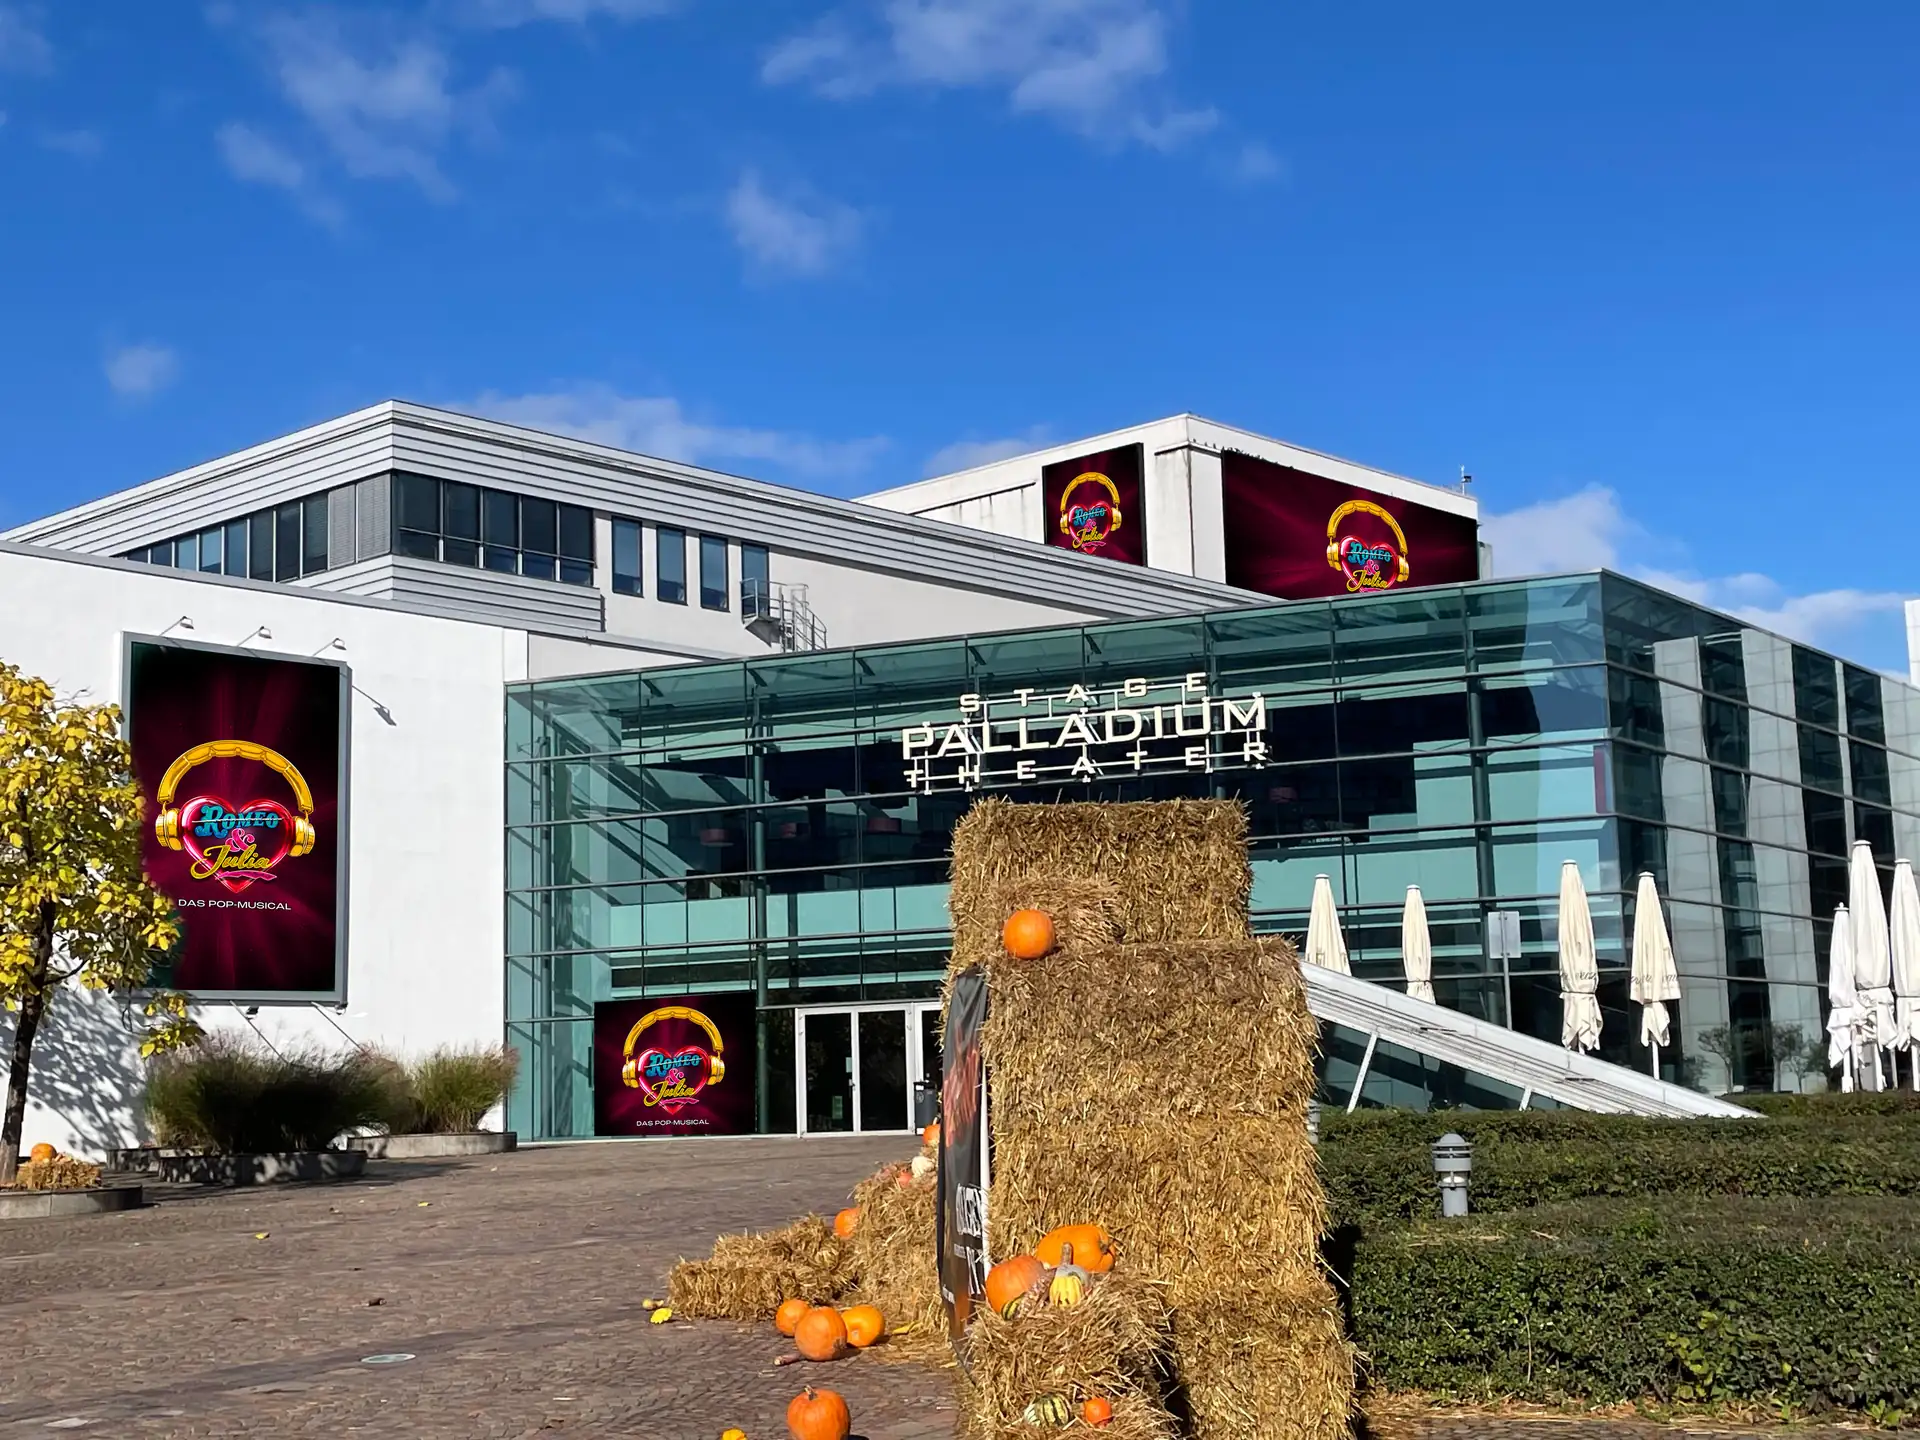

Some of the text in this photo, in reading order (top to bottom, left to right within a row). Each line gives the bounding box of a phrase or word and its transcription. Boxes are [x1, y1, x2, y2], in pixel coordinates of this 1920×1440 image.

[1072, 526, 1104, 549] Julia
[1347, 541, 1392, 566] ROMEO
[1364, 559, 1379, 576] &
[1346, 570, 1389, 593] Julia
[959, 672, 1207, 713] STAGE
[902, 697, 1266, 760] PALLADIUM
[903, 741, 1273, 788] THEATER
[194, 805, 280, 839] ROMEO
[225, 828, 255, 852] &
[190, 843, 273, 880] Julia
[178, 899, 291, 911] DAS POP-MUSICAL
[645, 1053, 701, 1077] ROMEO
[665, 1067, 685, 1086] &
[643, 1078, 697, 1107] Julia
[654, 1119, 709, 1127] POP-MUSICAL
